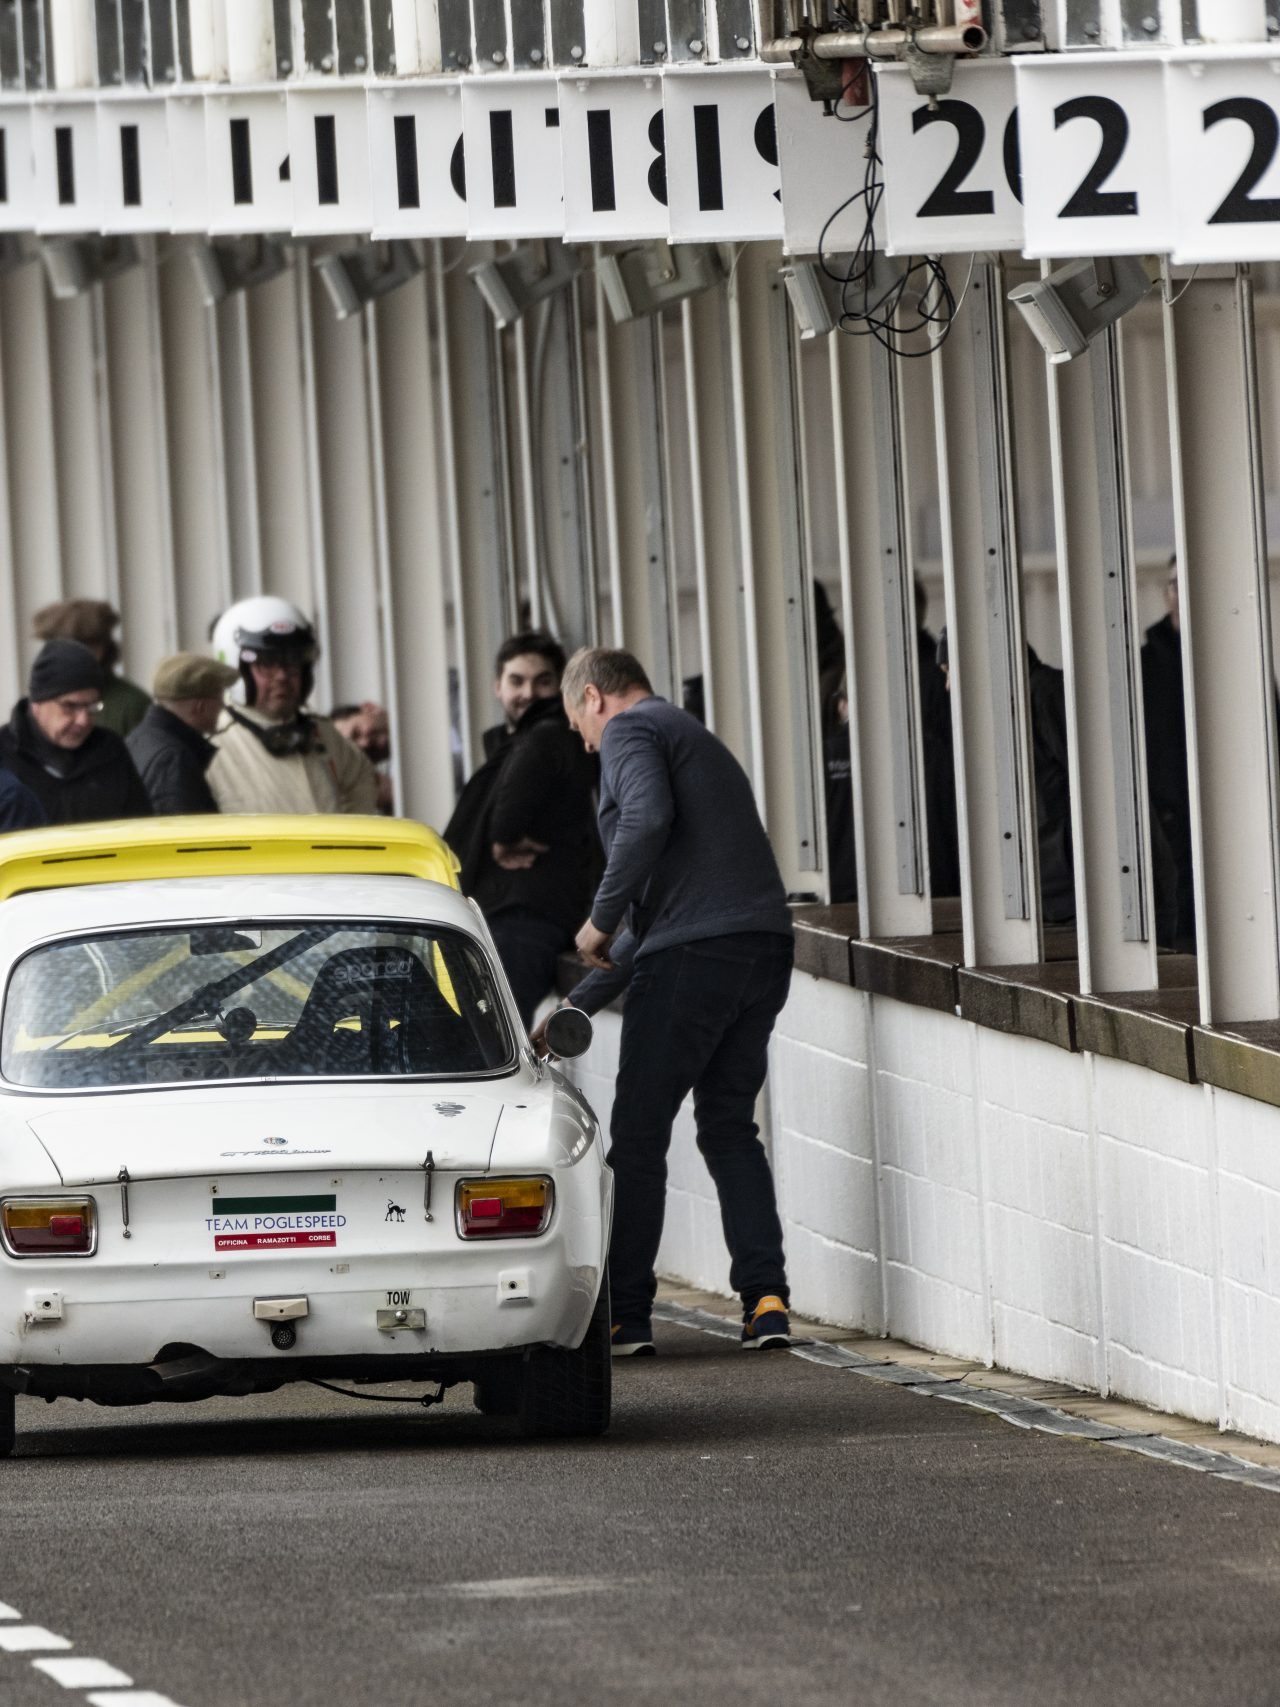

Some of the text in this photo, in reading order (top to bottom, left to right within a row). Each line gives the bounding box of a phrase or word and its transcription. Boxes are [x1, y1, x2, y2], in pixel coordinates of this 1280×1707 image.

[205, 1215, 347, 1231] TEAM POGLESPEED
[218, 1239, 248, 1247] OFFICINA
[257, 1236, 297, 1245] RAMAZOTTI
[387, 1291, 410, 1305] TOW
